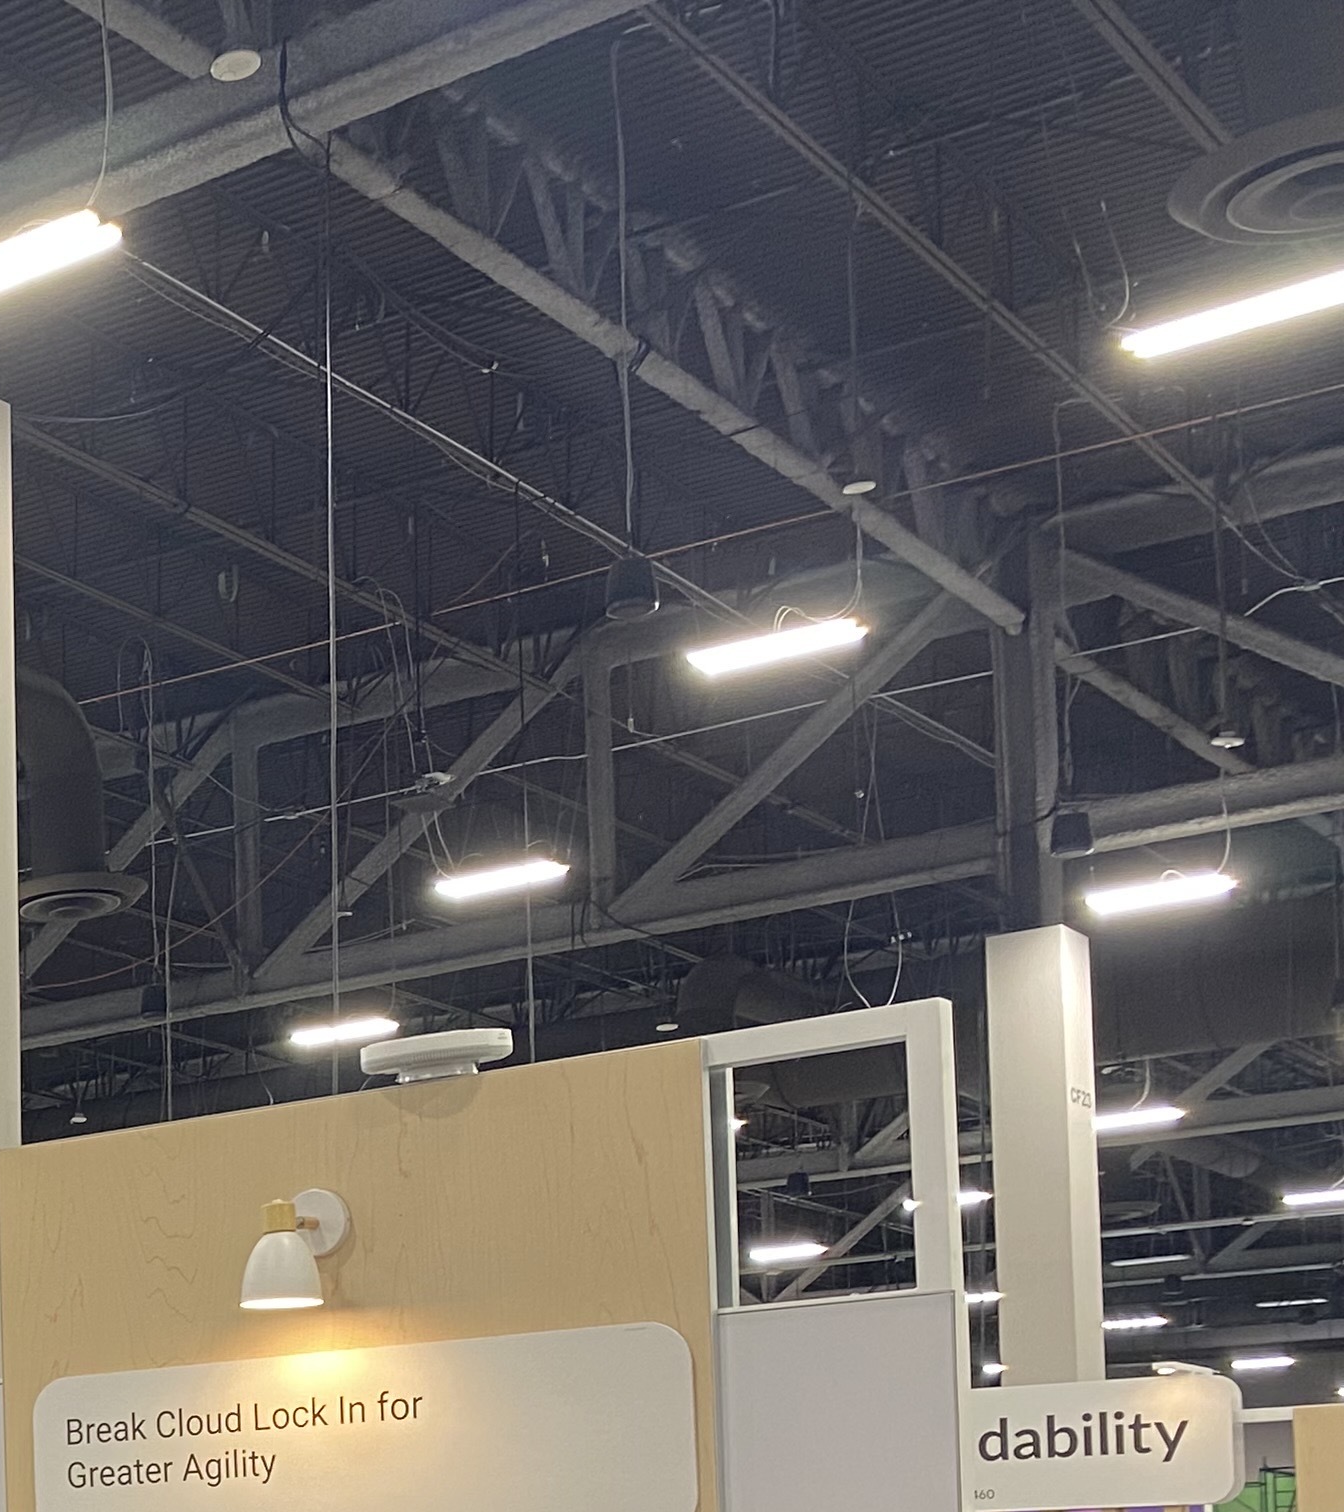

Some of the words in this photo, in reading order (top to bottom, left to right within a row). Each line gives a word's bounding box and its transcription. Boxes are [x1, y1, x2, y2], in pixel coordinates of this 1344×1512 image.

[66, 1411, 147, 1445] Break
[156, 1403, 242, 1438] Cloud
[254, 1397, 328, 1431] Lock
[339, 1396, 366, 1425] In
[377, 1391, 423, 1422] for
[978, 1411, 1189, 1463] dability
[67, 1459, 174, 1488] Greater
[182, 1449, 276, 1488] Agility
